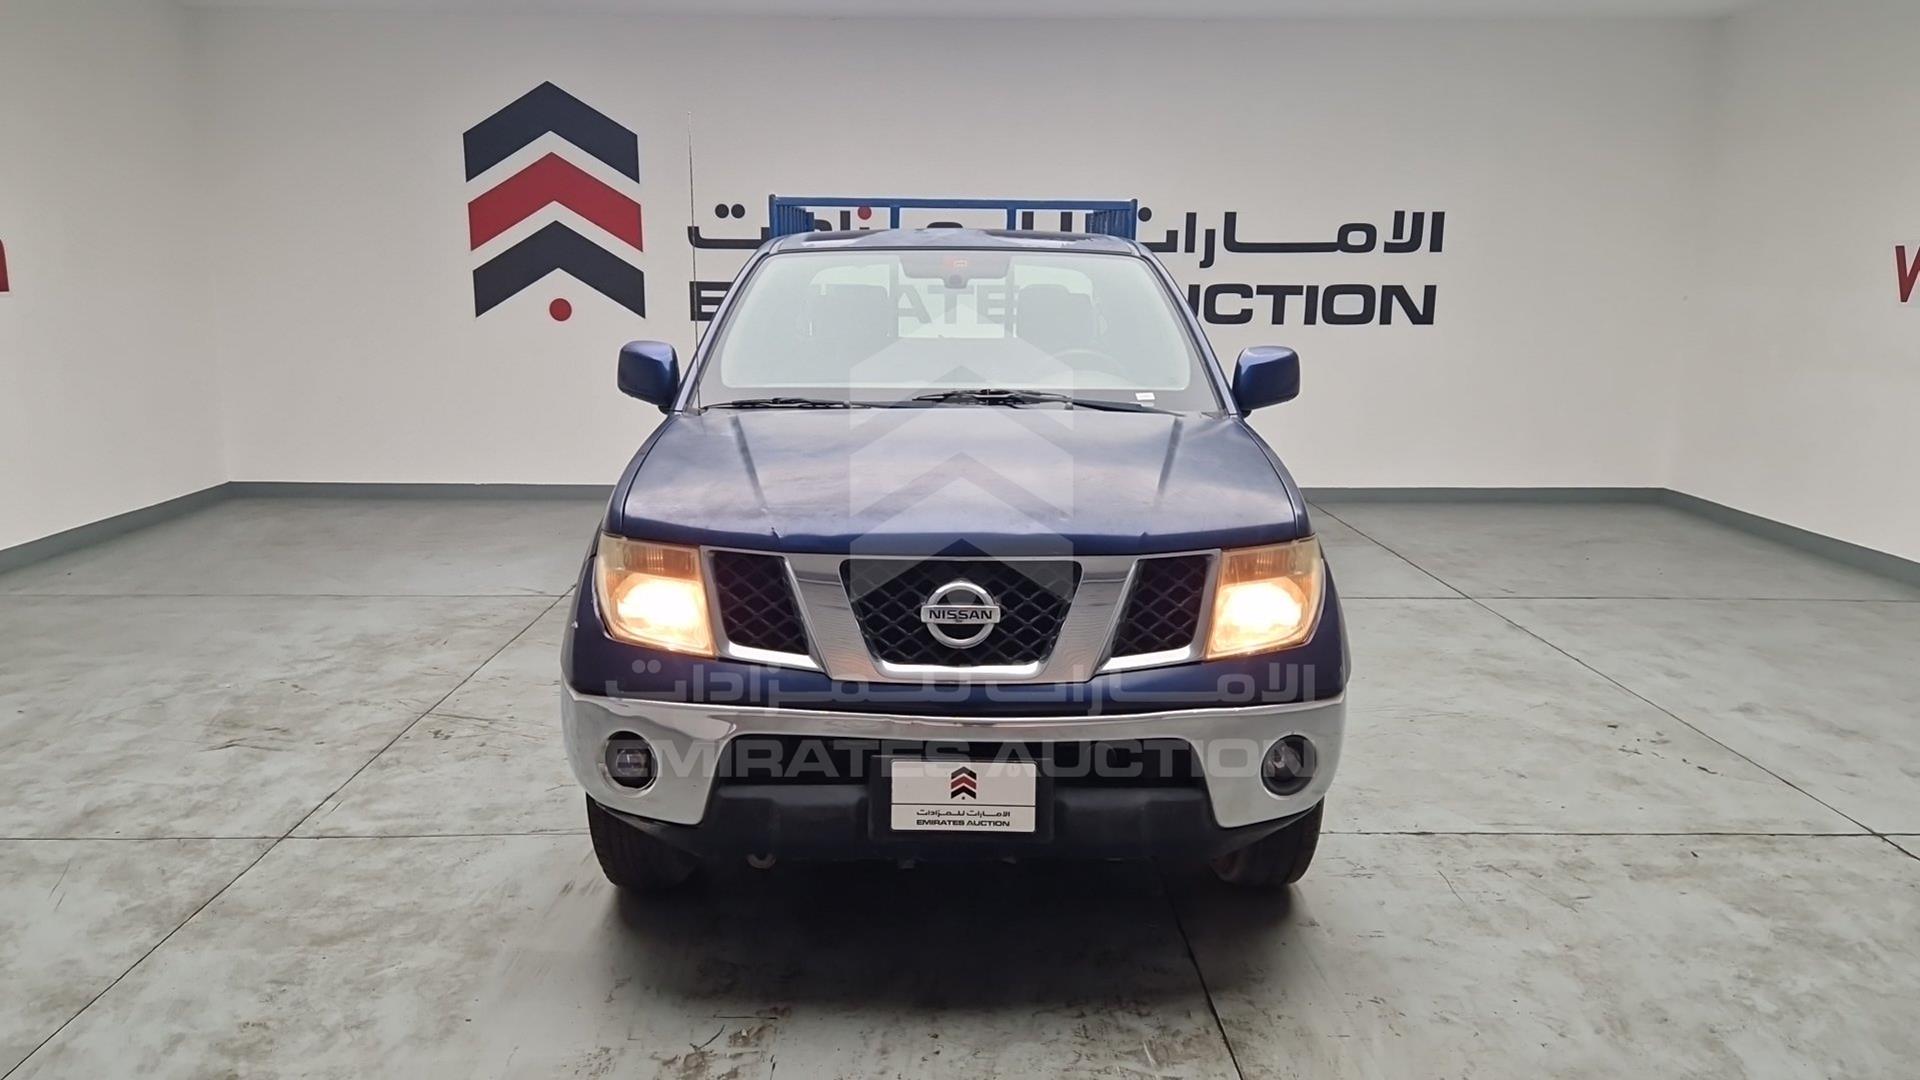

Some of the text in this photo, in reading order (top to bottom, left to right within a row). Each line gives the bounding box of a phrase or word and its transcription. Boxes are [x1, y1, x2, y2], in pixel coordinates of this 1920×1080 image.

[1187, 283, 1437, 325] CTION
[928, 609, 993, 620] NISSAN
[966, 819, 1010, 827] AUCTION
